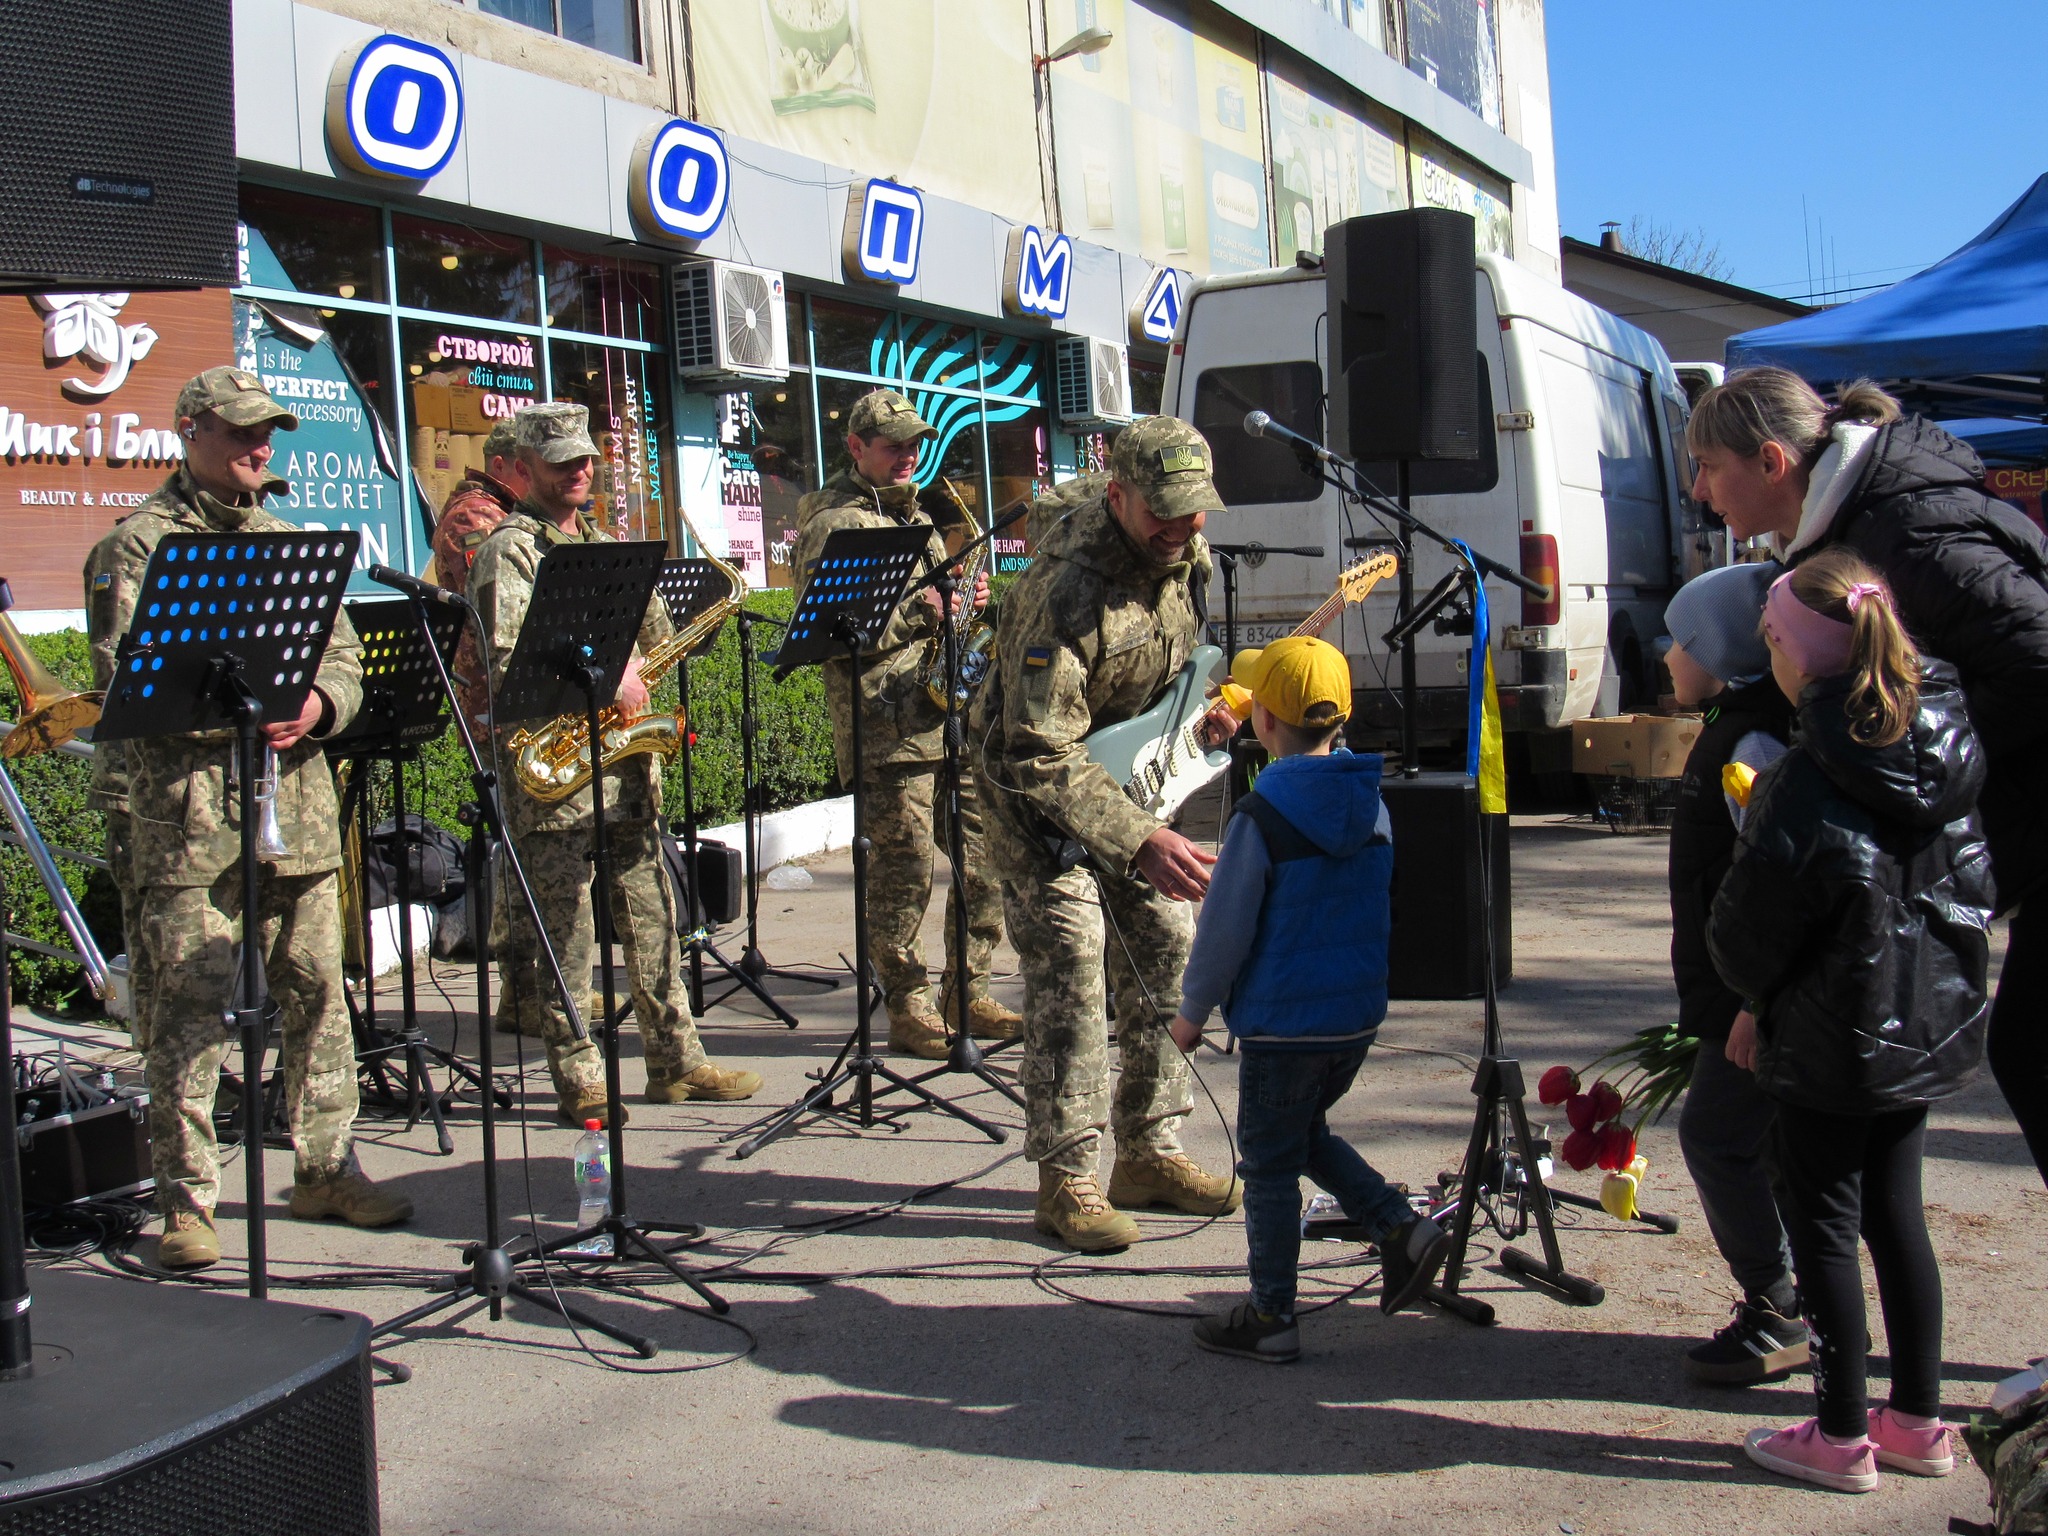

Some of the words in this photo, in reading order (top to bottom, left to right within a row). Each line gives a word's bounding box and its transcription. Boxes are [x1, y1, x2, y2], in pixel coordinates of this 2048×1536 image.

[76, 178, 151, 198] dBTechnologies
[263, 347, 276, 369] is
[280, 349, 302, 371] the
[438, 335, 535, 368] СТВОРЮЙ
[262, 374, 349, 401] PERFECT
[468, 366, 493, 386] свій
[496, 374, 534, 391] стиль
[625, 375, 638, 423] ART
[644, 390, 655, 423] UP
[288, 402, 362, 432] accessory
[287, 450, 384, 480] AROMA
[629, 428, 642, 484] NAIL
[646, 429, 662, 500] MAKE
[610, 416, 630, 542] PARFUMS
[719, 457, 760, 486] Care
[20, 489, 76, 506] BEAUTY
[82, 491, 95, 506] &
[289, 481, 385, 510] SECRET
[722, 484, 762, 507] HAIR
[737, 508, 762, 522] shine
[747, 551, 762, 560] LIFE
[993, 540, 1001, 553] BE
[1002, 540, 1026, 553] HAPPY
[1000, 557, 1016, 571] AND
[1247, 626, 1284, 643] 8344
